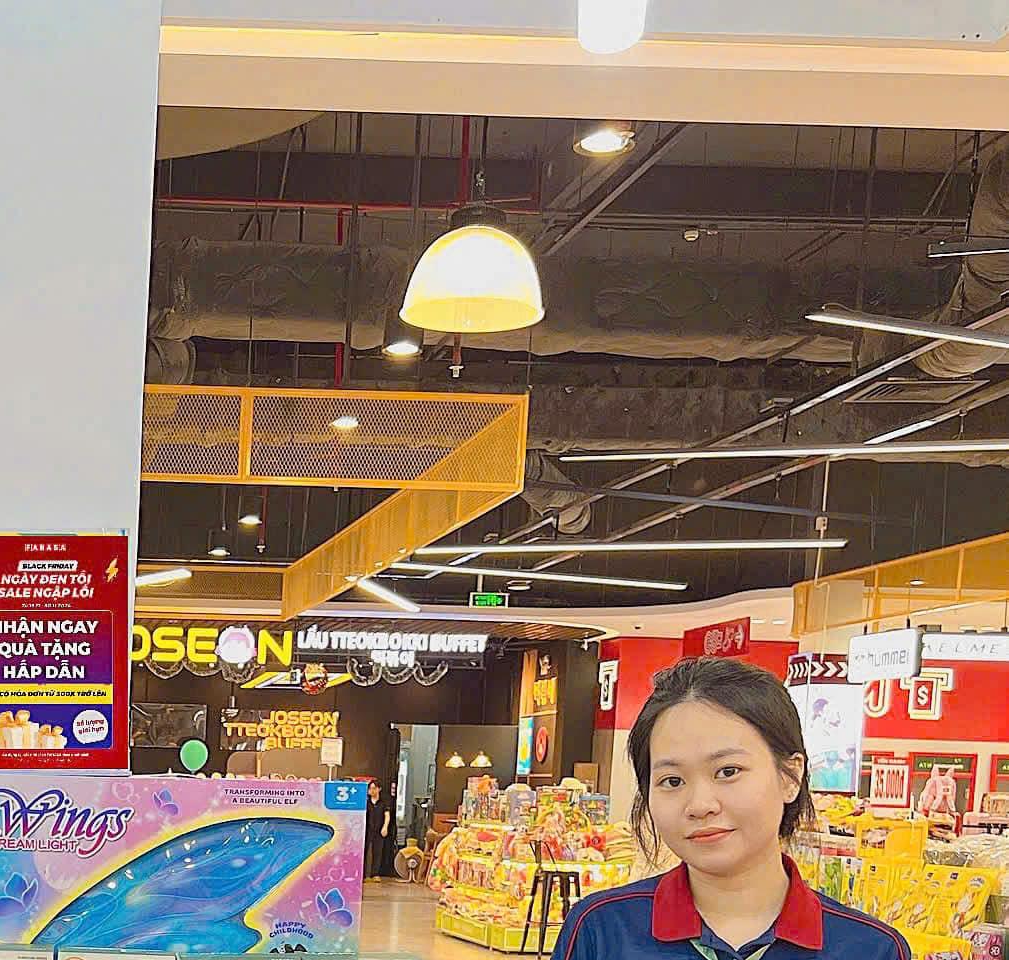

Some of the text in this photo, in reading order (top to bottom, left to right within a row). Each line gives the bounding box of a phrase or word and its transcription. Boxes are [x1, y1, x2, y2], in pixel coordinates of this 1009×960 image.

[0, 572, 38, 585] NGÀY
[47, 620, 99, 634] NGAY
[40, 639, 91, 660] TẶNG
[3, 659, 85, 679] HẤP DẪN
[224, 788, 285, 796] TRANSFORMING
[239, 797, 283, 805] BEAUTIFUL
[38, 839, 79, 851] LIGHT
[274, 921, 307, 929] HAPPY
[269, 927, 314, 939] CHILDHOOD
